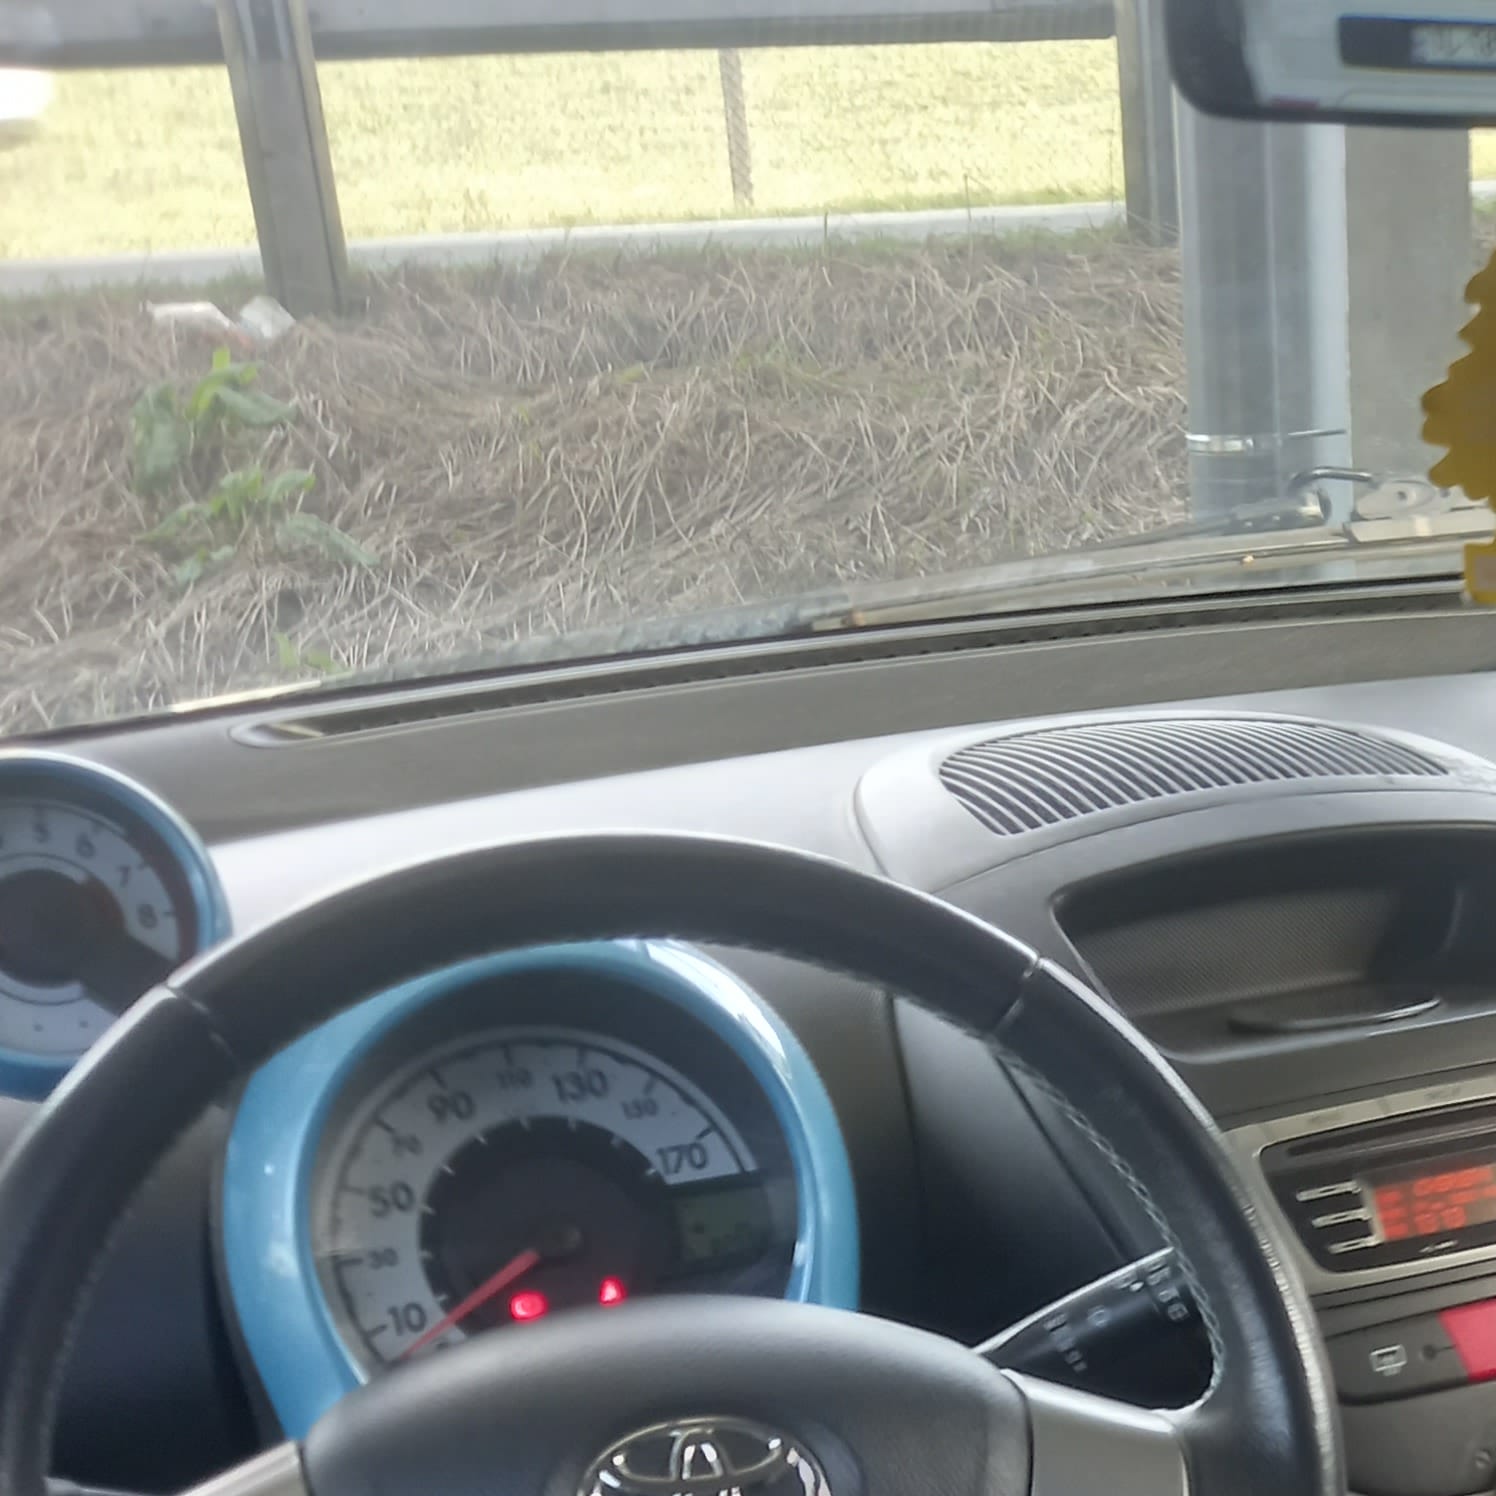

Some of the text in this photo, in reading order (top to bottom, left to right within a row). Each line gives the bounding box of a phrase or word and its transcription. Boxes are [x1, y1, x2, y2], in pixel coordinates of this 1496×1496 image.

[656, 1142, 708, 1176] 170
[368, 1180, 416, 1218] 50
[387, 1301, 427, 1337] 10
